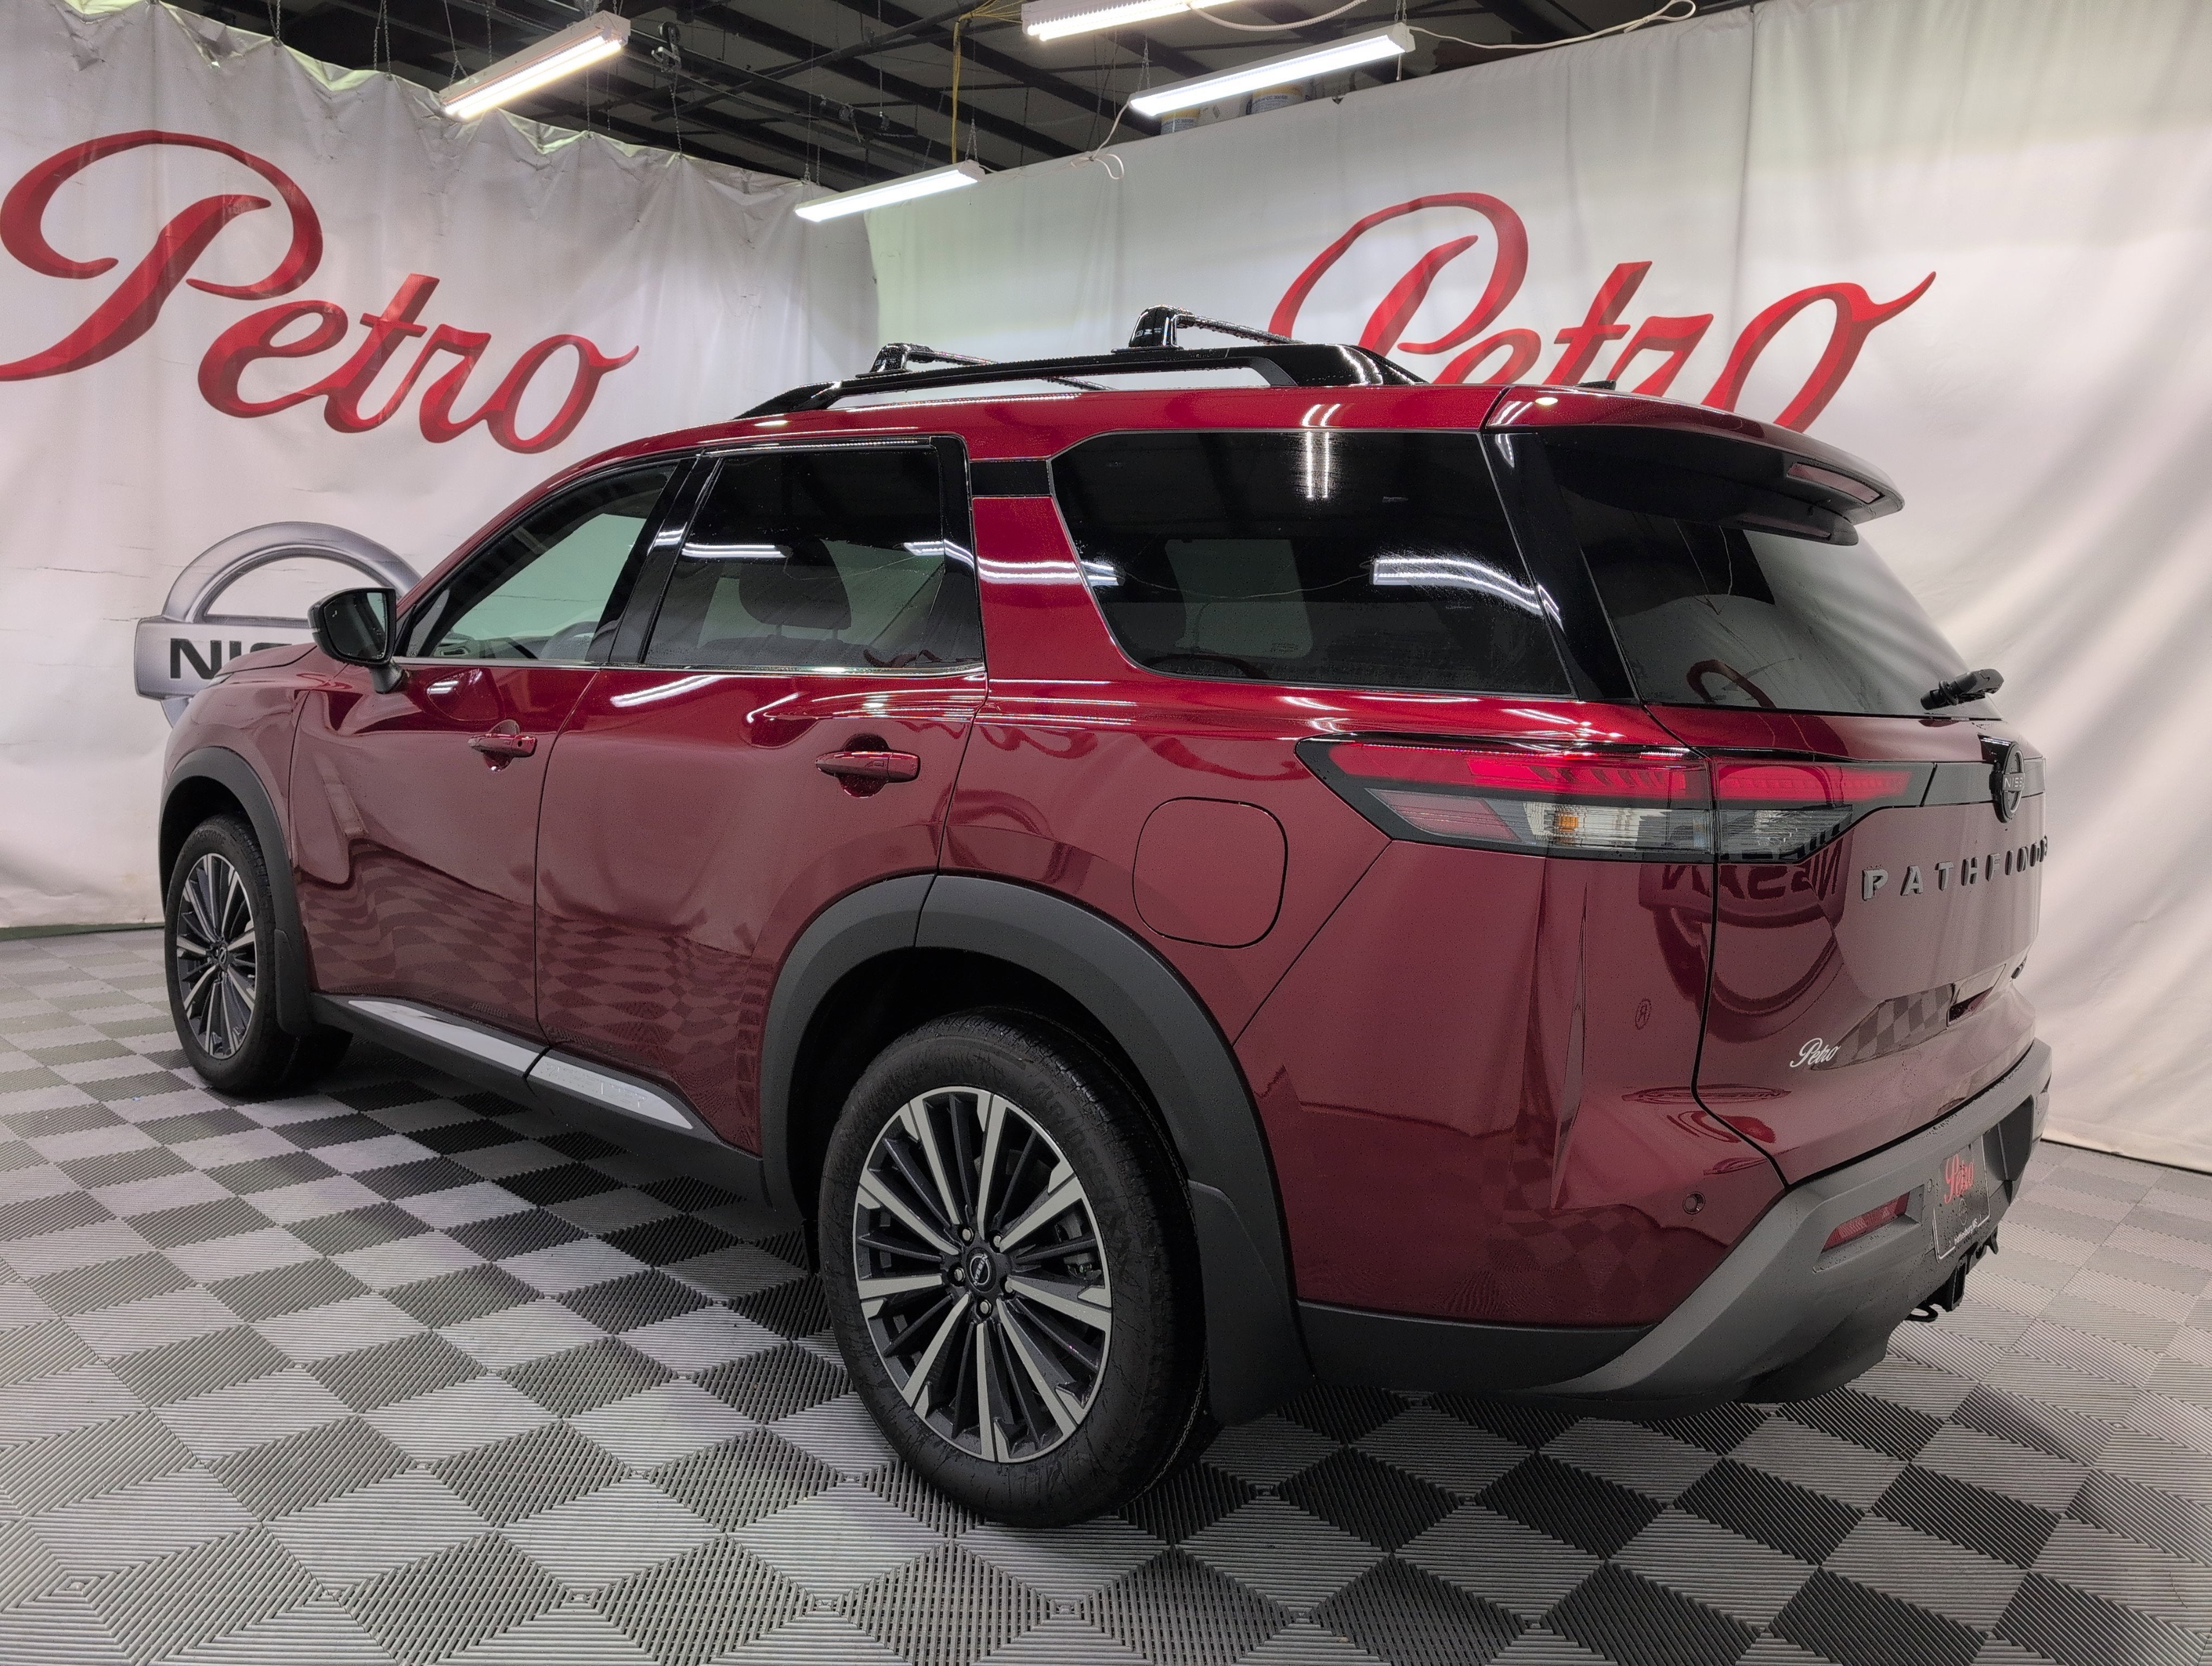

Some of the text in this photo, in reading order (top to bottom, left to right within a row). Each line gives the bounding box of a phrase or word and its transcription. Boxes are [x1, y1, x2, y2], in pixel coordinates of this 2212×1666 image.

[0, 130, 639, 454] Petro
[2004, 777, 2024, 788] NISS
[1790, 1037, 1842, 1068] Petro
